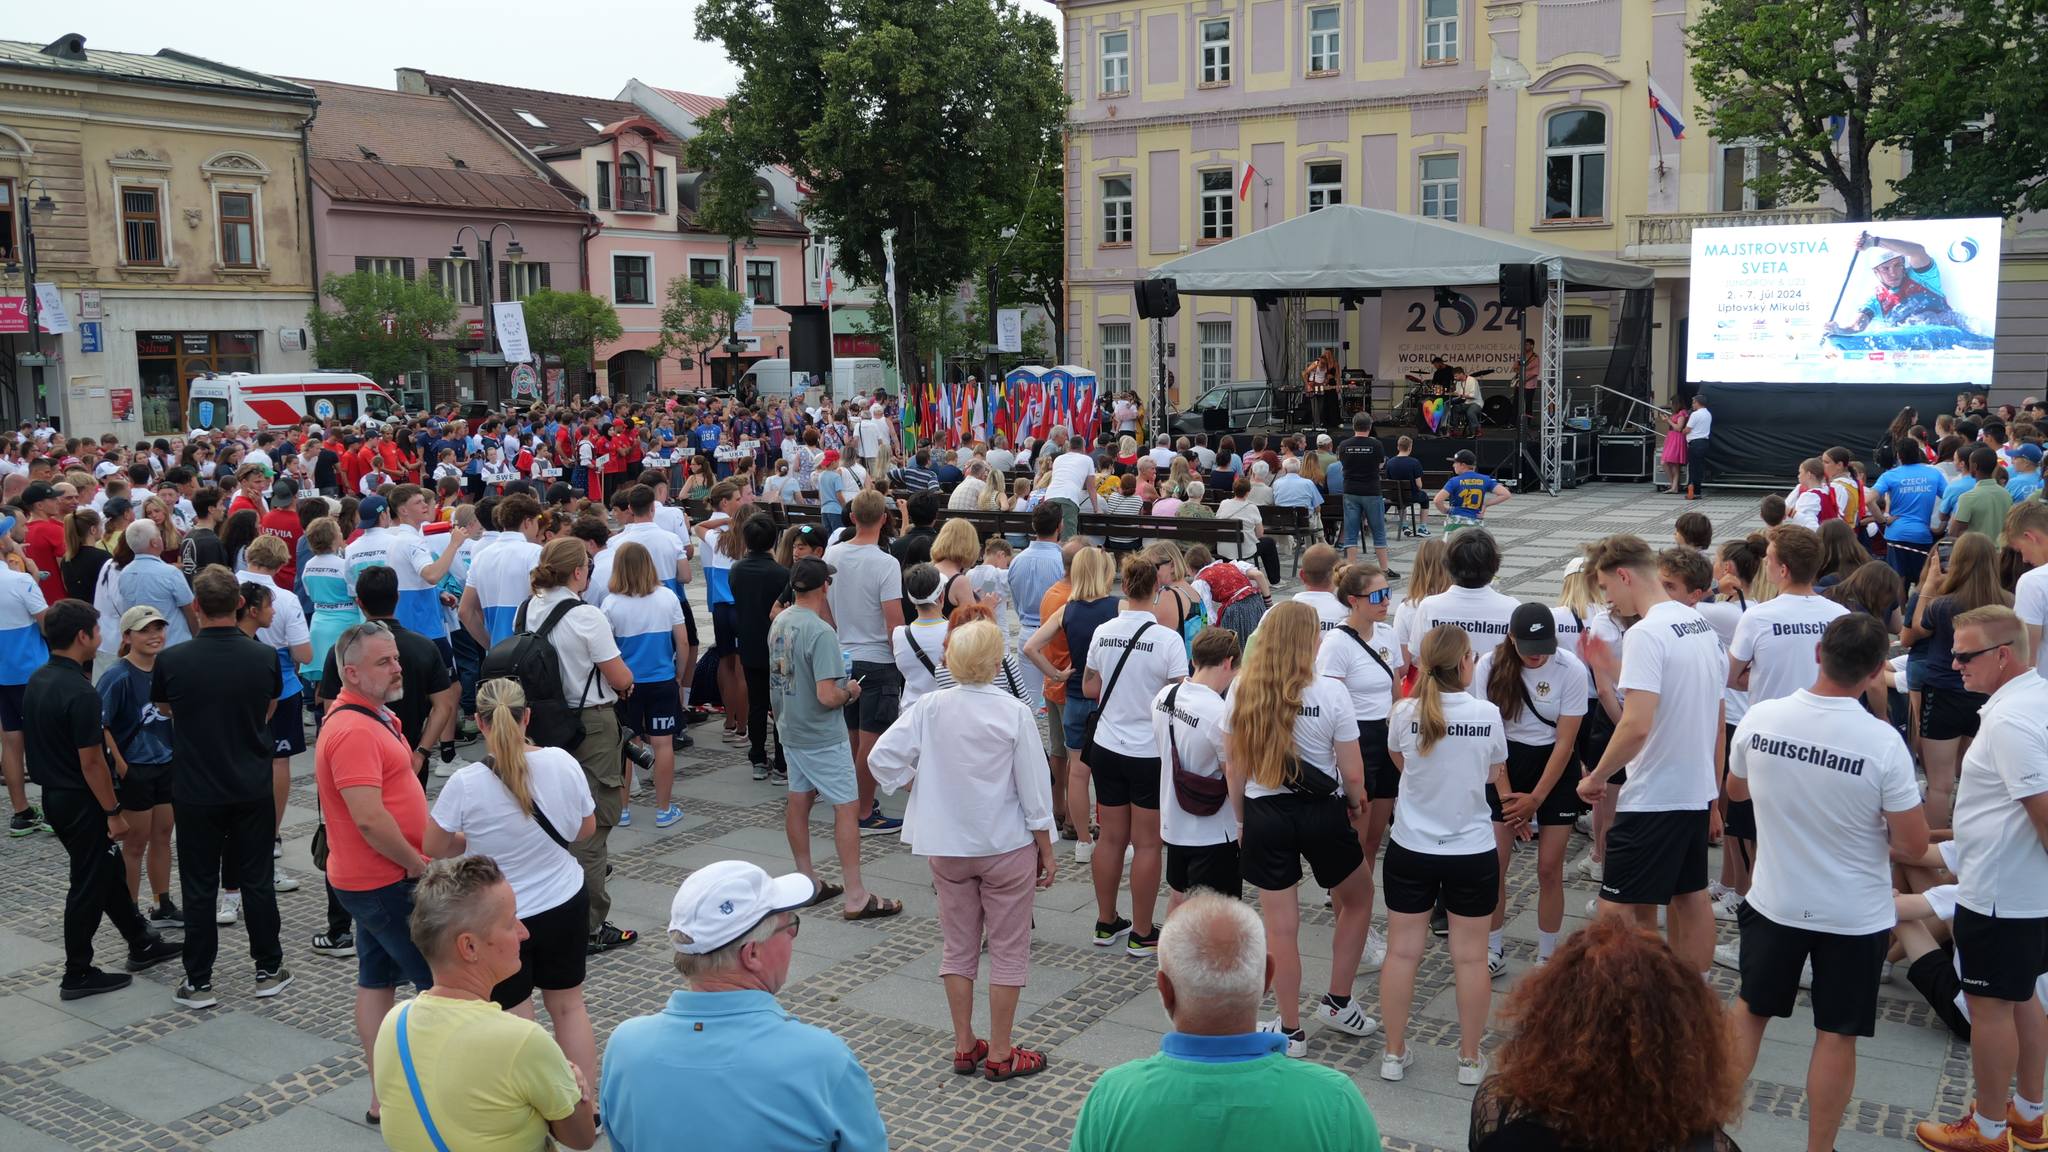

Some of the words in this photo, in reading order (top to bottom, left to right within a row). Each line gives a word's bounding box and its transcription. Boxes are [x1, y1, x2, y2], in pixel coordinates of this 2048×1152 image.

[1704, 237, 1829, 256] MAJSTROVSTVÁ
[1741, 261, 1789, 274] SVETA
[1777, 289, 1802, 299] 2024
[1398, 353, 1437, 363] WORLD
[701, 433, 715, 441] USA
[1900, 476, 1928, 486] CZECH
[1458, 488, 1483, 509] 10
[652, 715, 676, 730] ITA
[1751, 733, 1865, 777] Deutschland
